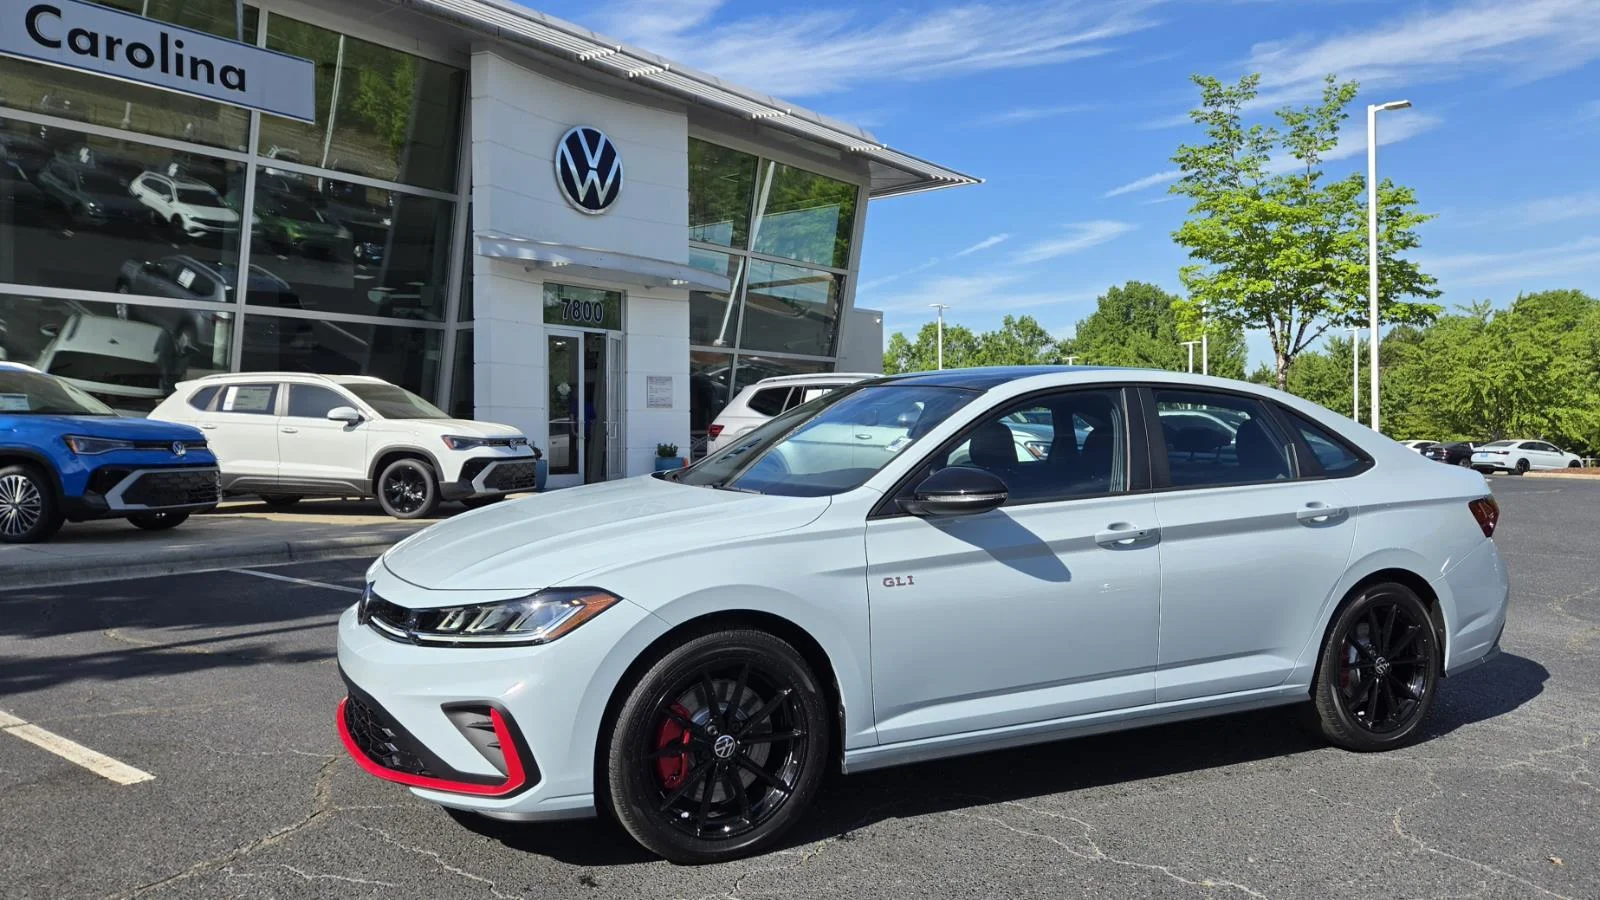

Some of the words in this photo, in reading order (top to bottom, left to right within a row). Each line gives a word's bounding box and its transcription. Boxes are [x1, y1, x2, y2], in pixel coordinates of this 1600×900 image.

[25, 4, 246, 92] Carolina
[556, 126, 623, 214] VW
[561, 298, 603, 322] 7800
[882, 575, 914, 588] GLI
